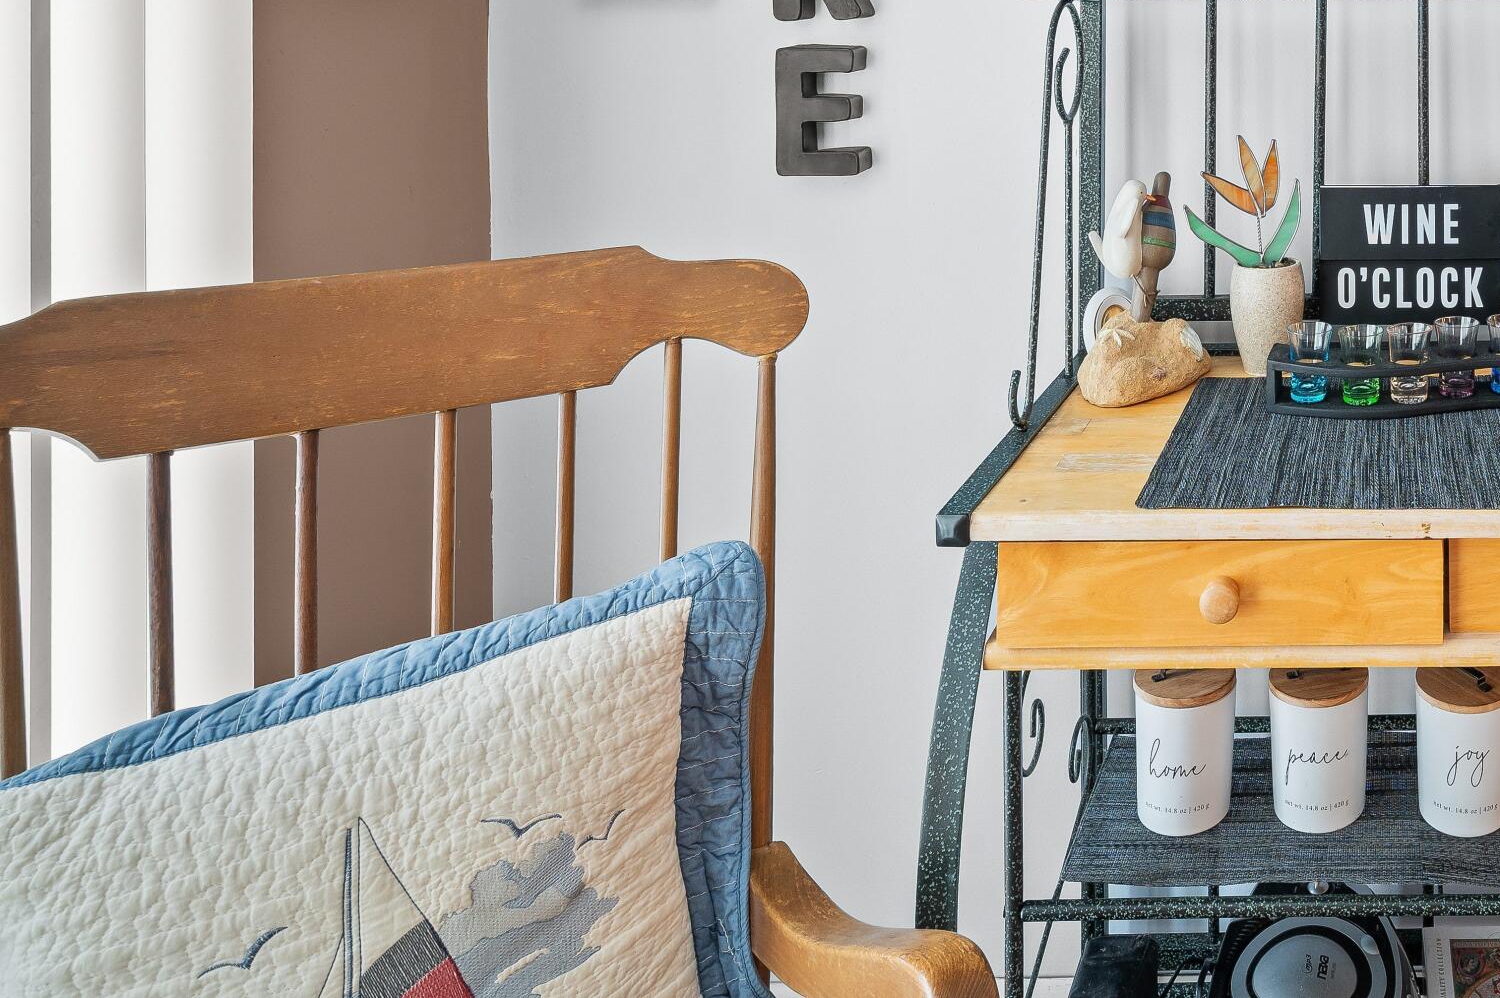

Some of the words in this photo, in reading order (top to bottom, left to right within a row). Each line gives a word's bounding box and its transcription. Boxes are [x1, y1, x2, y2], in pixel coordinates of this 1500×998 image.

[1363, 204, 1459, 244] WINE
[1337, 266, 1484, 309] O'CLOCK
[1150, 738, 1206, 779] home
[1285, 749, 1348, 786] peace
[1446, 745, 1490, 787] joy
